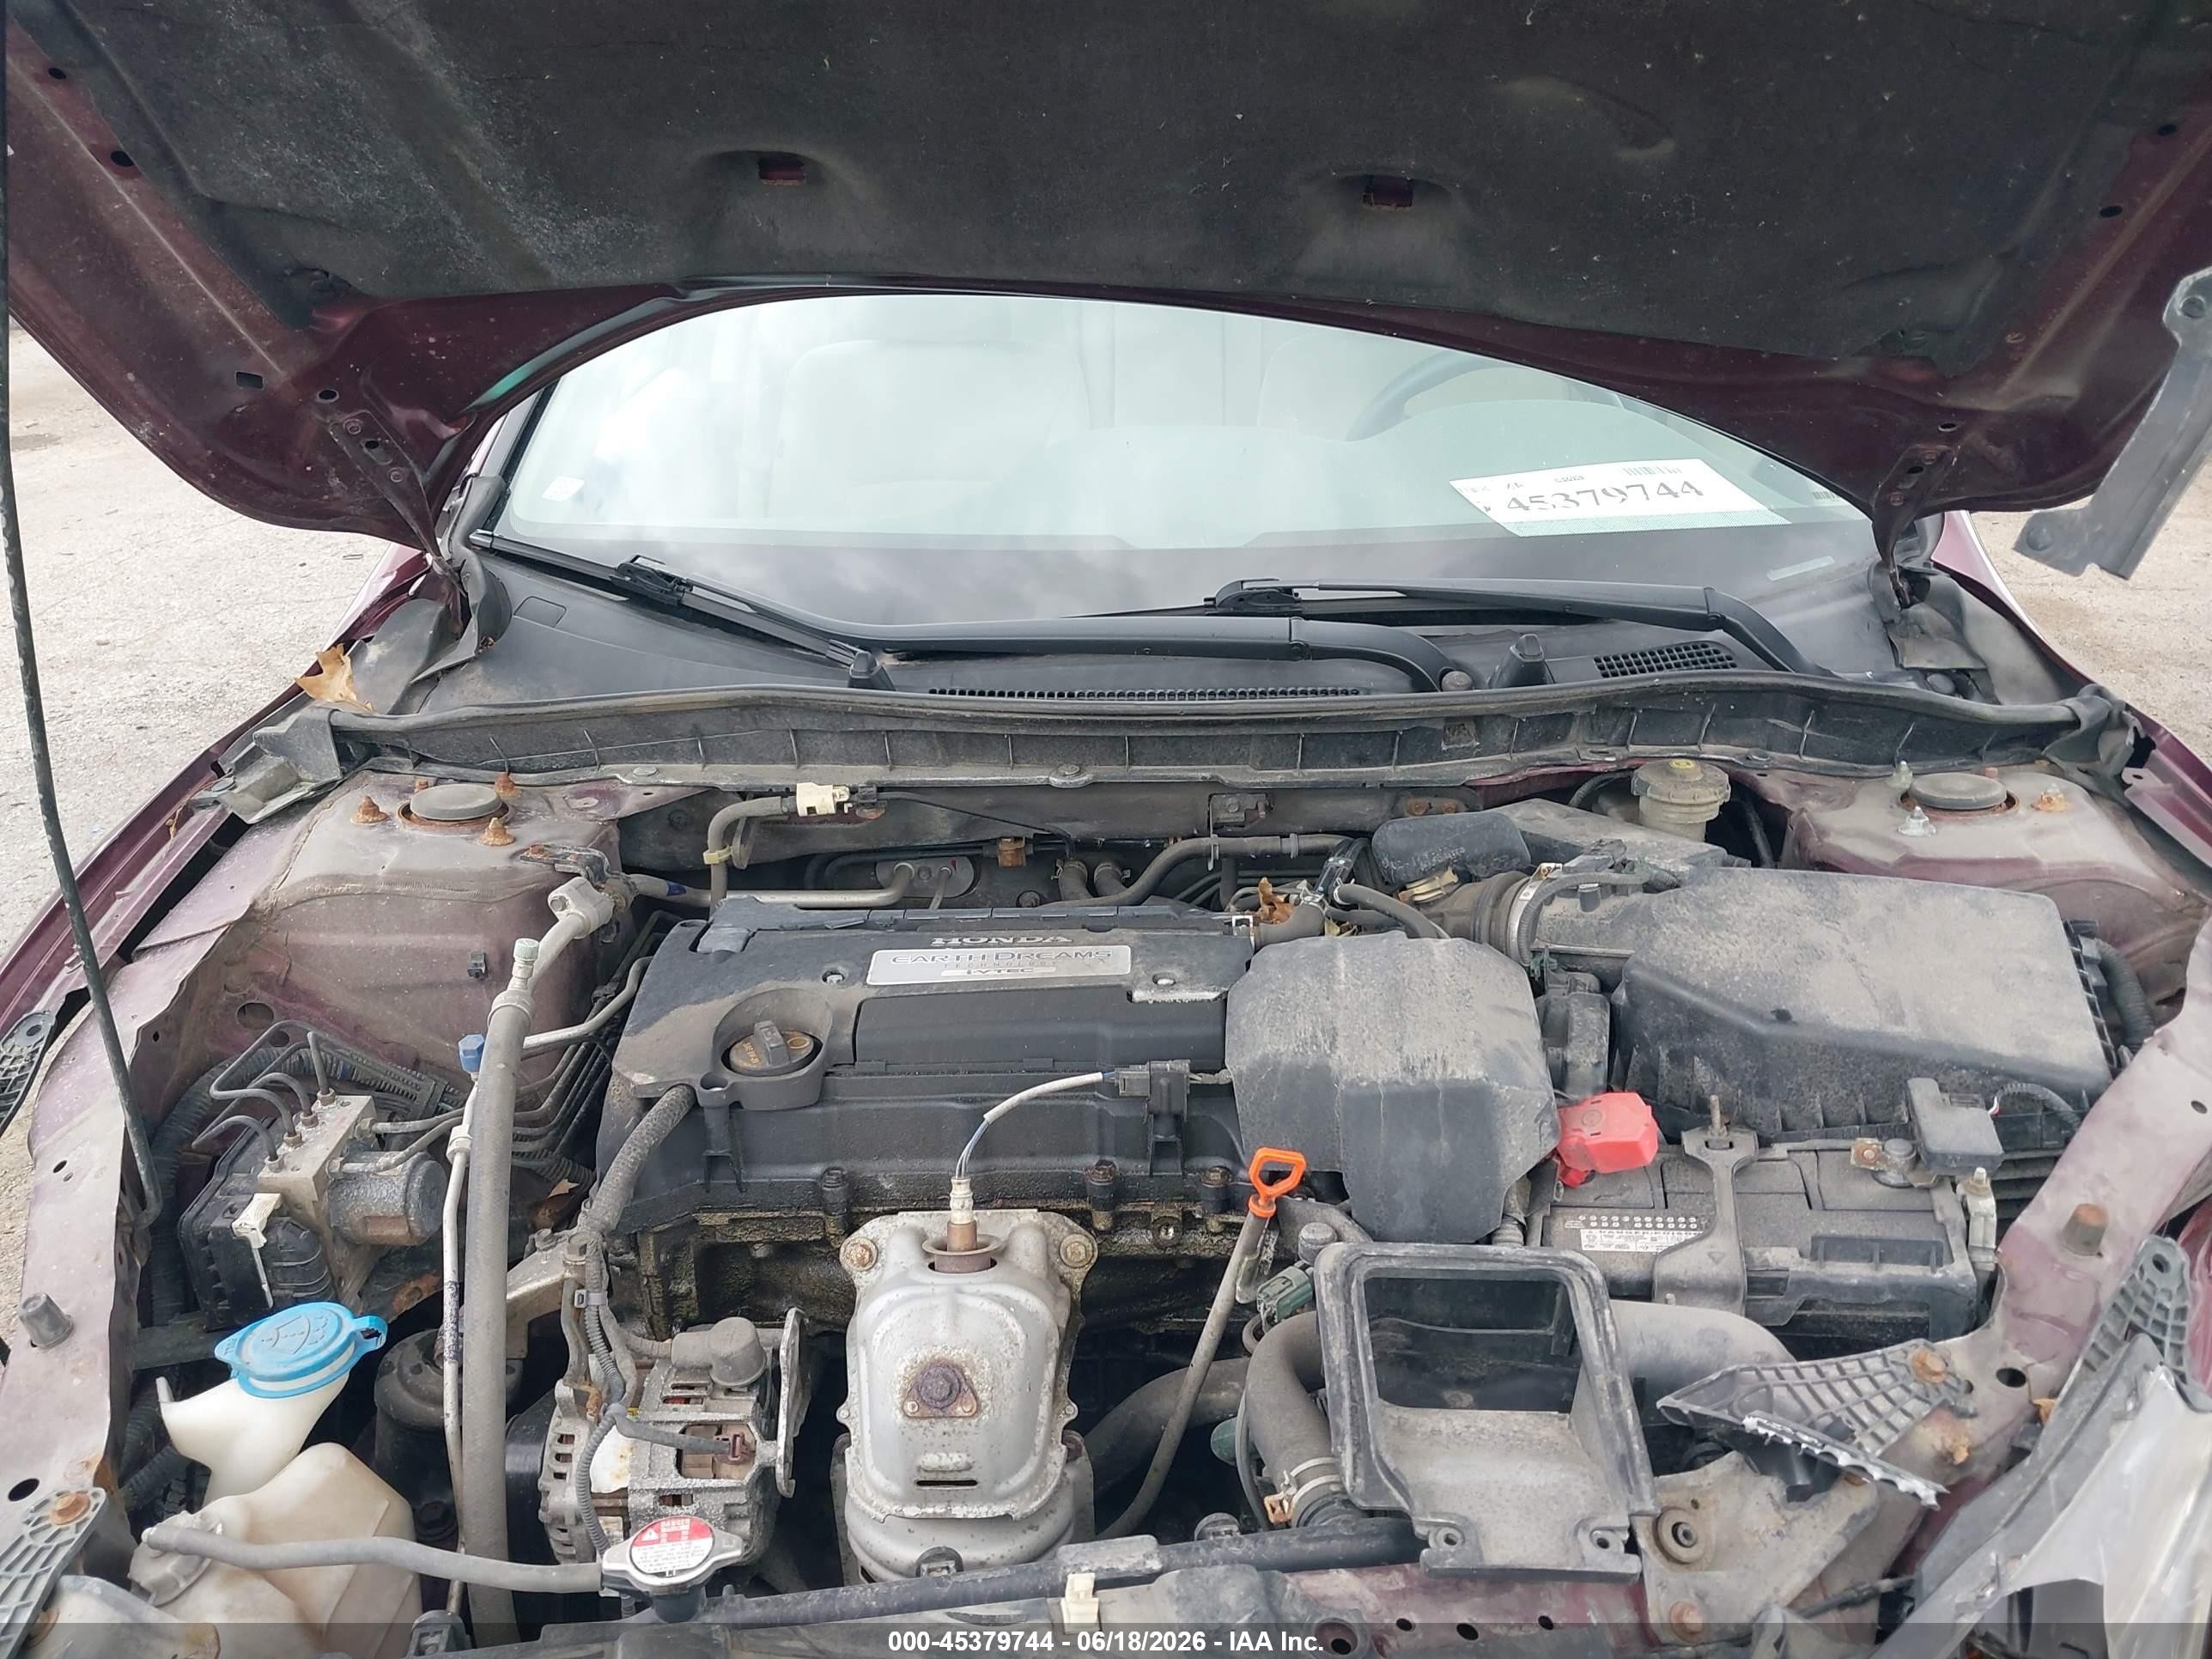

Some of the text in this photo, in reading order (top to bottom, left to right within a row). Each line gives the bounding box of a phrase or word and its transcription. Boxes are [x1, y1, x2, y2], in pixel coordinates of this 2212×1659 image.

[1507, 480, 1705, 512] 45379744
[931, 935, 1073, 946] HONDA
[891, 950, 1113, 964] EARTH DREAMS
